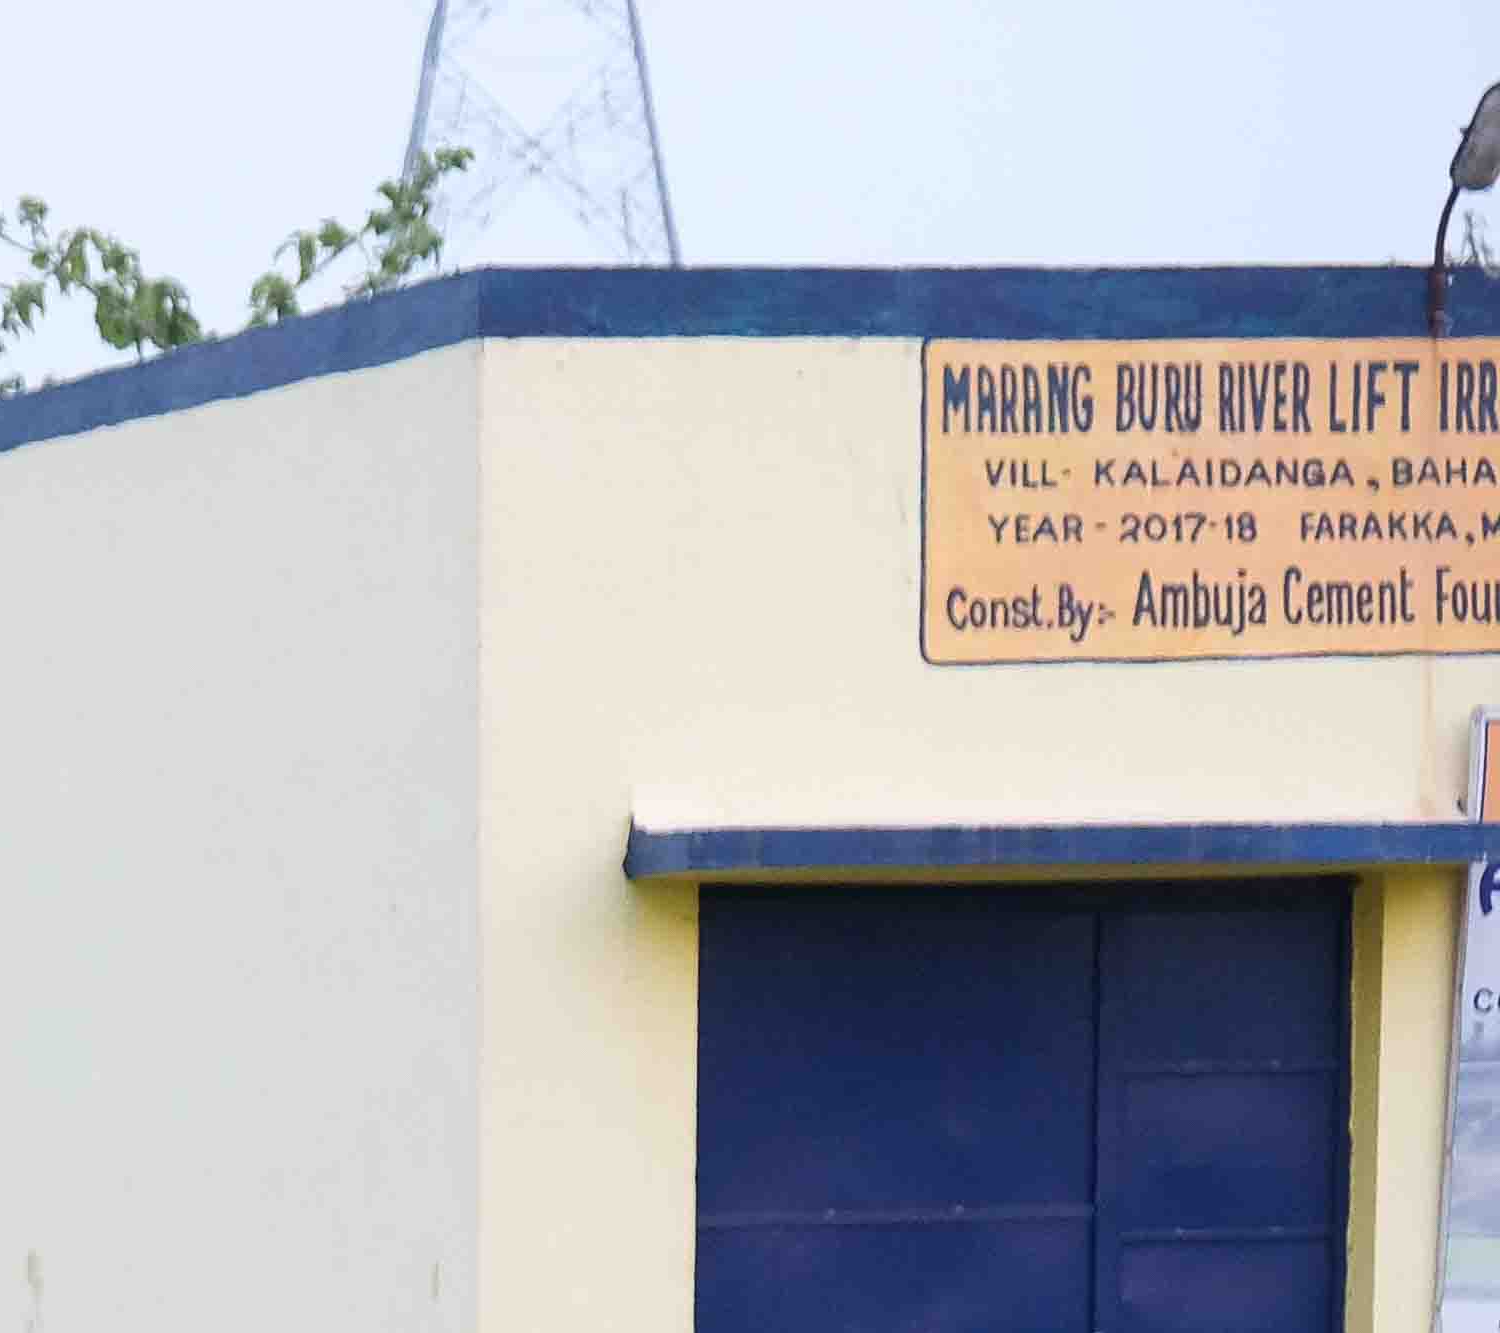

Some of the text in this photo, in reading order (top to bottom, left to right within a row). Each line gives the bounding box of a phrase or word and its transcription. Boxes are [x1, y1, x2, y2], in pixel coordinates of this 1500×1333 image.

[943, 358, 1499, 434] MARANG BURU RIVER LIFT IRR
[1392, 455, 1498, 487] BAHA
[988, 511, 1083, 544] YEAR
[1119, 510, 1258, 543] 2017-18
[1132, 568, 1267, 636] Ambuja
[1283, 565, 1415, 626] Cement
[1474, 988, 1500, 1014] C
